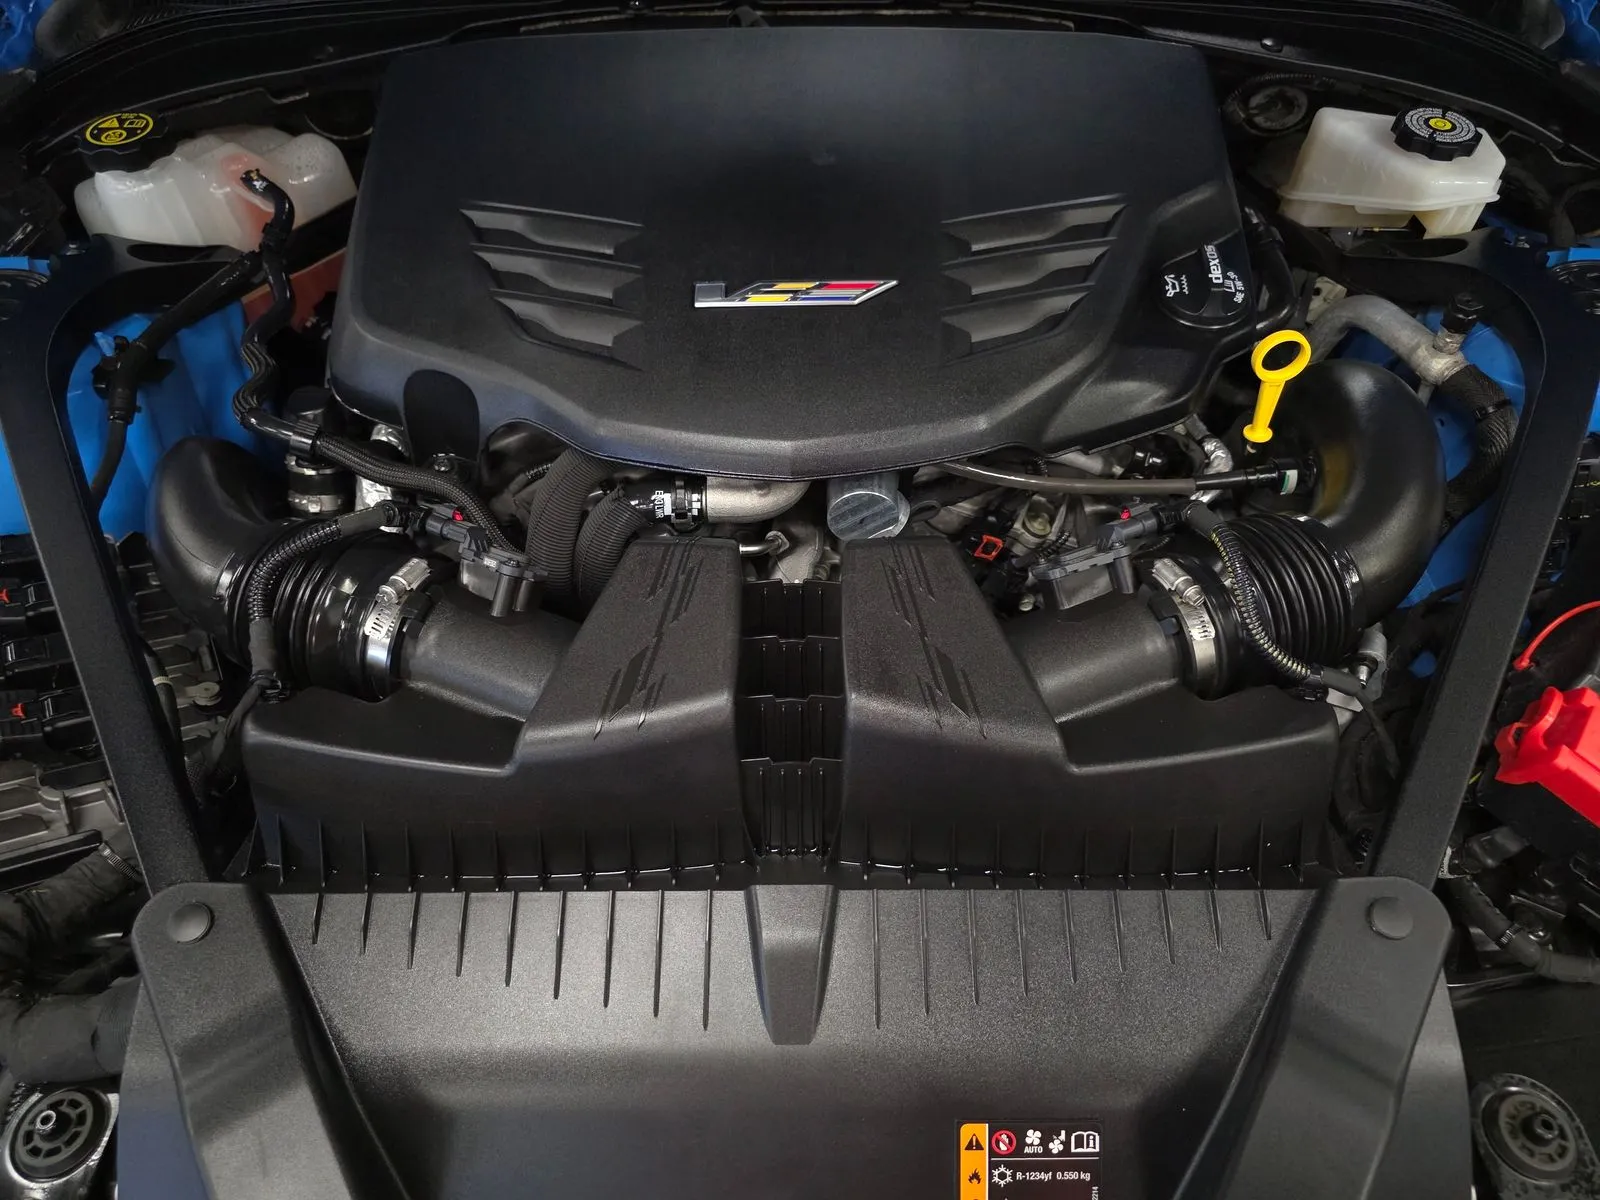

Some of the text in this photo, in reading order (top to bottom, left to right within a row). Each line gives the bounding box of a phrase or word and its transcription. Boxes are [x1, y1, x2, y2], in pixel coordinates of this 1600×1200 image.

[1204, 244, 1223, 284] dexos
[1233, 291, 1245, 303] SAE
[1024, 1146, 1043, 1154] AUTO
[1016, 1171, 1091, 1182] R-1234yf 0.550 kg
